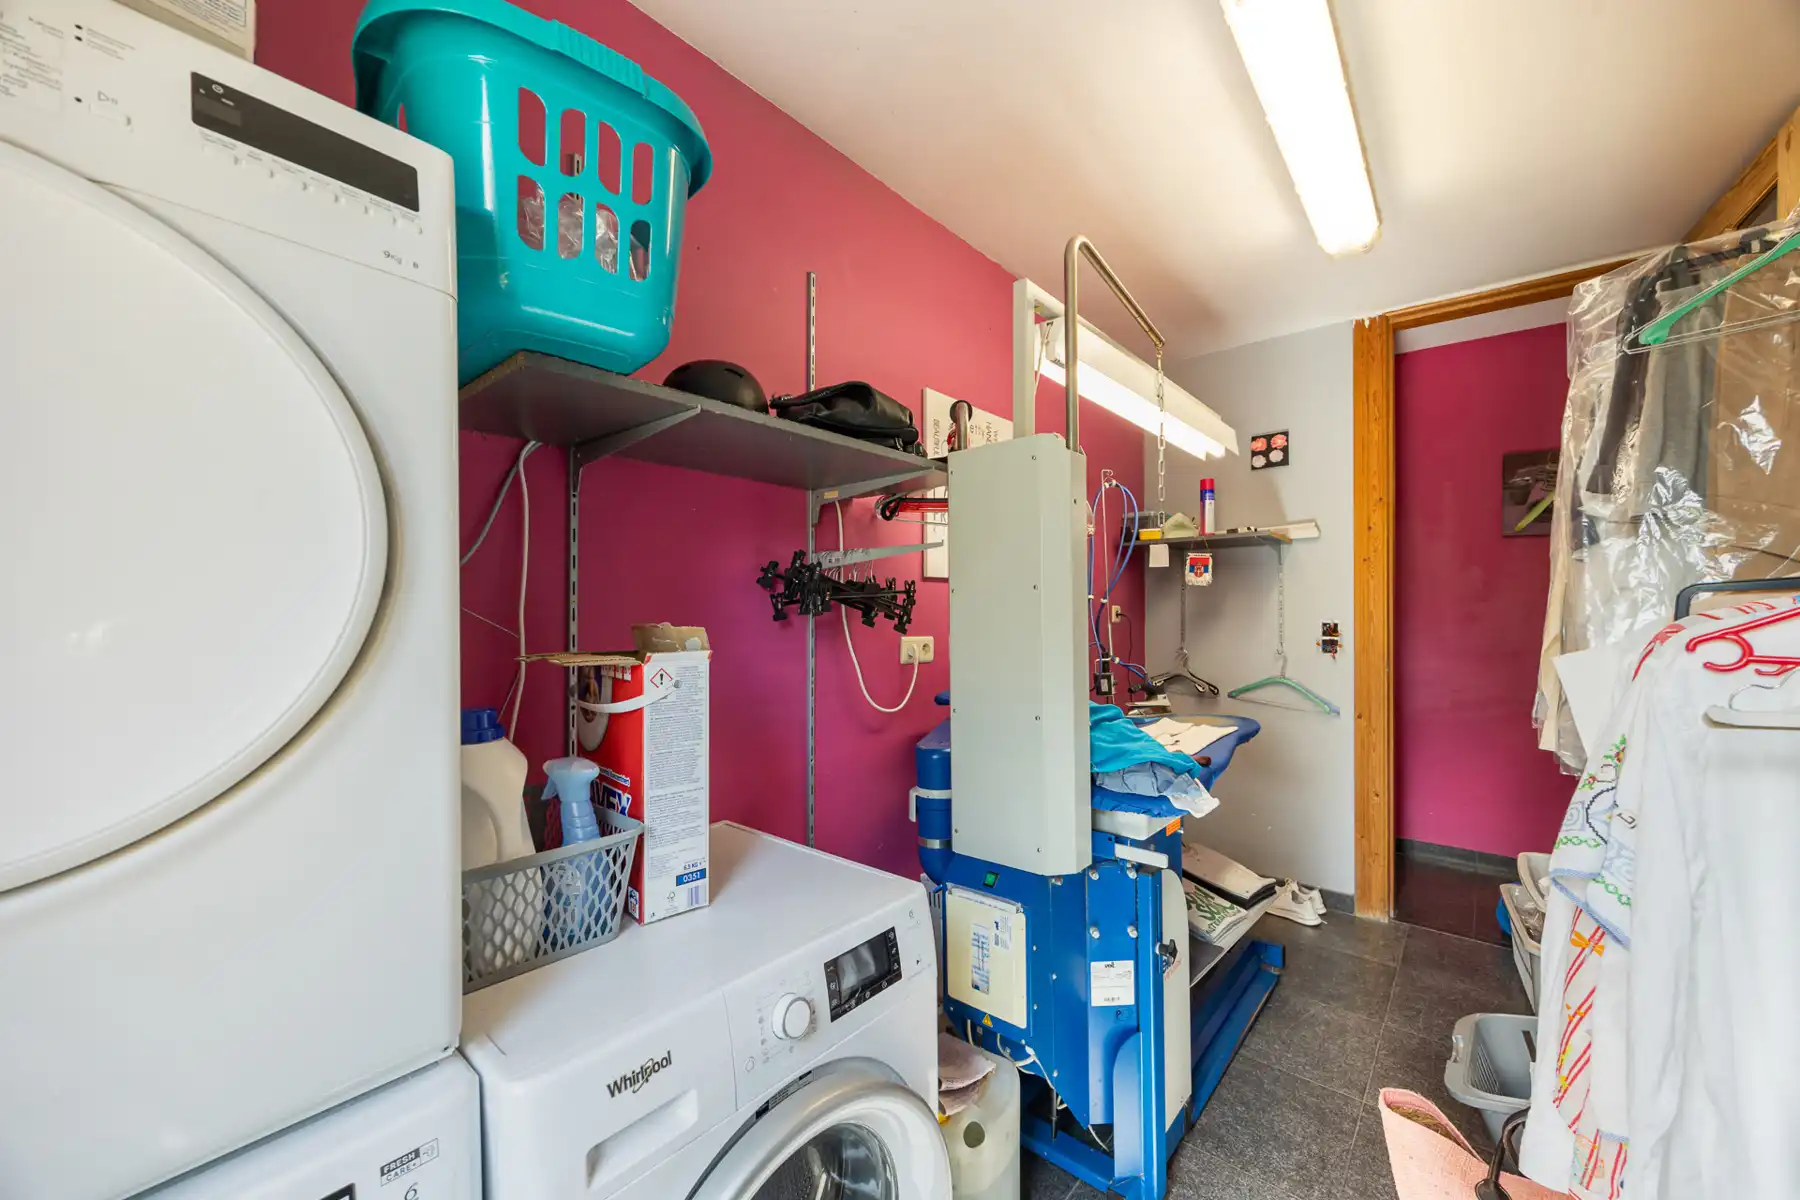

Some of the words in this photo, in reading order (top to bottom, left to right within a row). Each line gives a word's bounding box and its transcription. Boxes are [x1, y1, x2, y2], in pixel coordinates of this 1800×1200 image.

[682, 872, 701, 882] 0351
[606, 1050, 672, 1098] Whirlpool
[383, 1152, 416, 1174] FRESH
